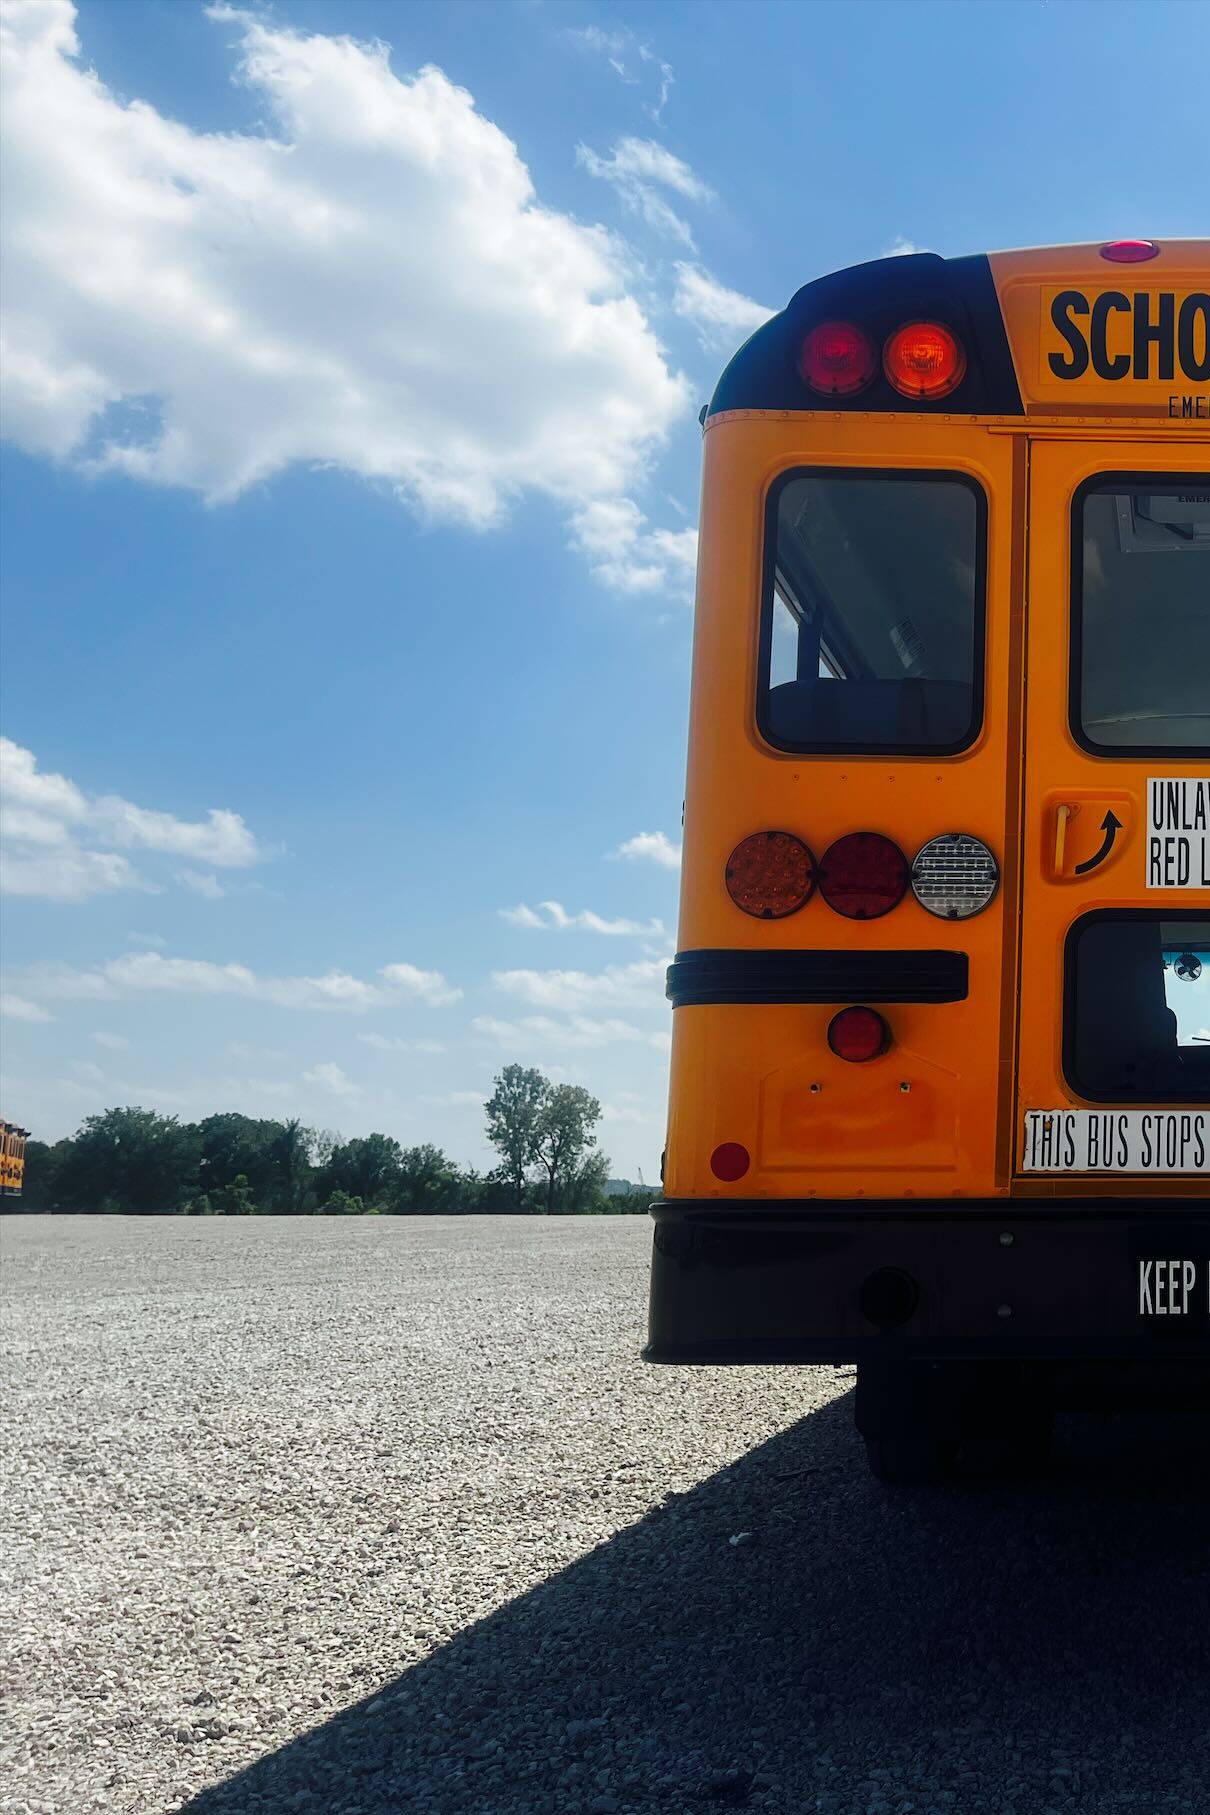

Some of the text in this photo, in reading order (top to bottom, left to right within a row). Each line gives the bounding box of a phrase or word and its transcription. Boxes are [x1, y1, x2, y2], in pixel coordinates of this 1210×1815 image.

[1150, 837, 1190, 886] RED
[1030, 1114, 1076, 1167] THIS
[1087, 1115, 1129, 1167] BUS
[1141, 1115, 1205, 1168] STOPS
[1139, 1260, 1196, 1315] KEEP
